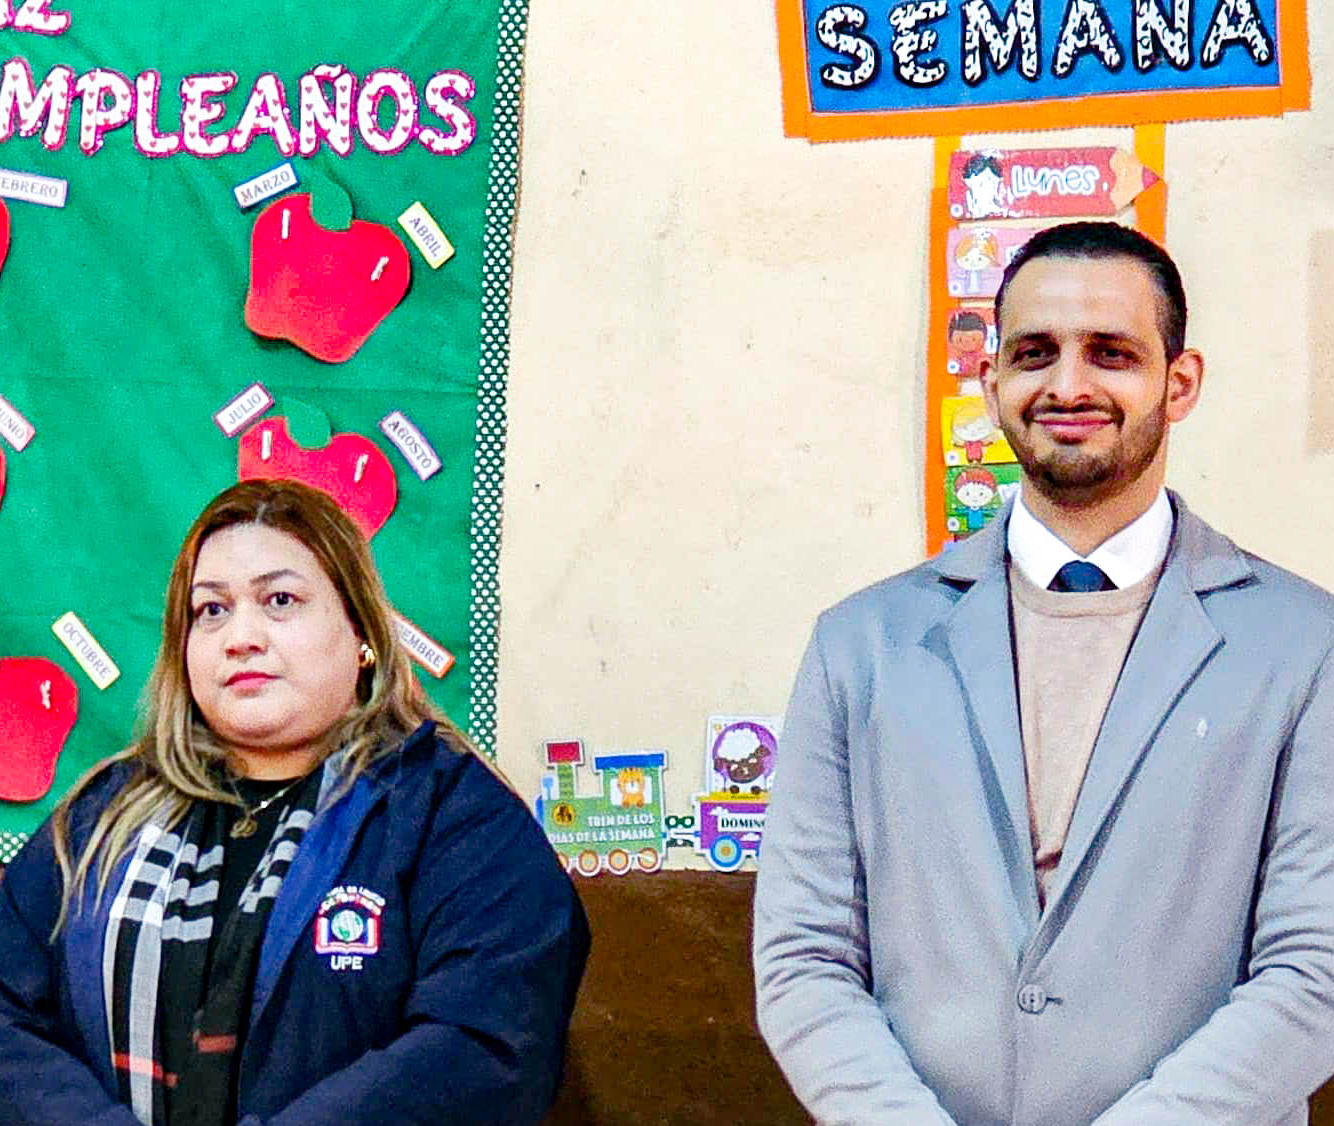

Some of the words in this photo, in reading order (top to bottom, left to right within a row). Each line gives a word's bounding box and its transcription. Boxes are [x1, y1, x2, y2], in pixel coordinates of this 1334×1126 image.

[816, 0, 1275, 86] SEMANA
[240, 170, 290, 202] MARZO
[409, 217, 443, 257] ABRIL
[228, 394, 262, 426] JULIO
[388, 420, 432, 470] AGOSTO
[63, 622, 111, 679] OCTUBRE
[397, 624, 443, 669] EMBRE
[634, 814, 654, 825] LOS
[331, 954, 363, 970] UPE
